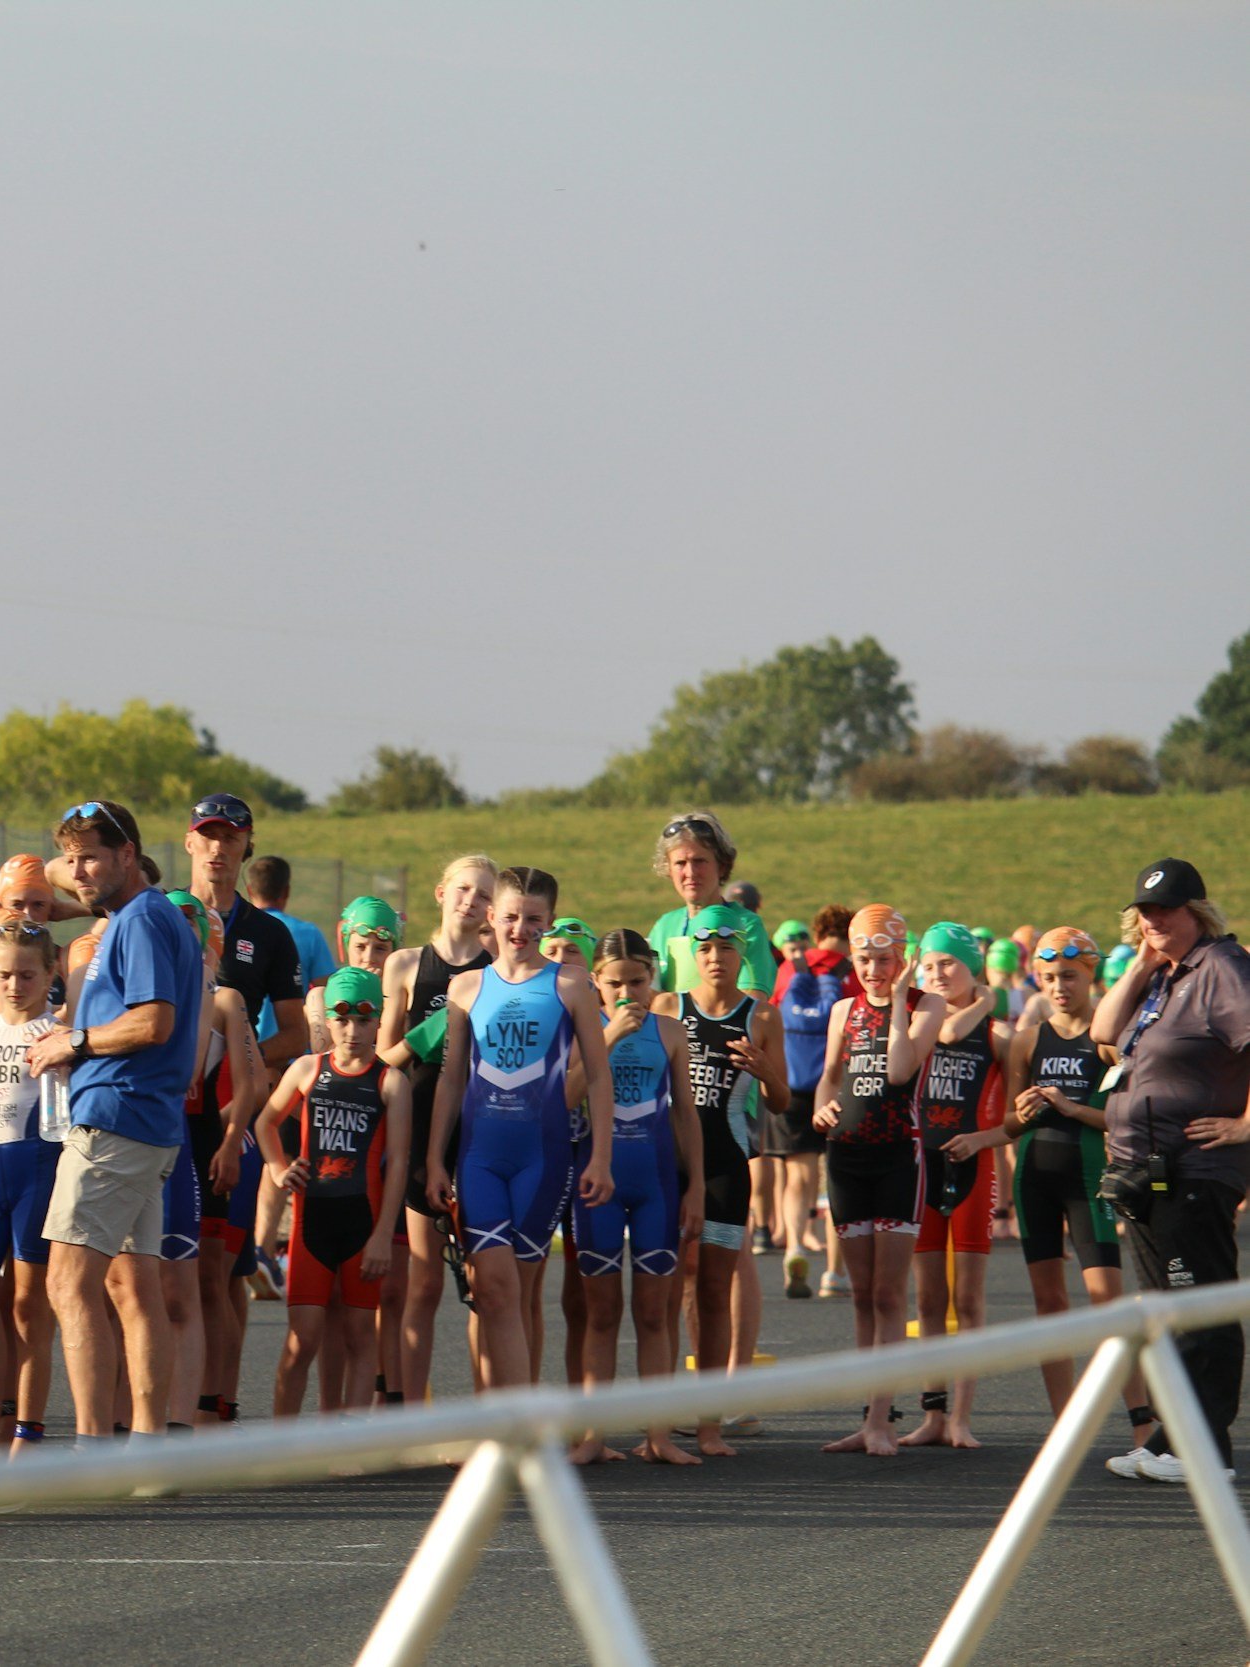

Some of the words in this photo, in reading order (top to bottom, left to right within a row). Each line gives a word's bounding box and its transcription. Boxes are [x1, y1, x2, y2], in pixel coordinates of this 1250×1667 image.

[485, 1021, 540, 1048] LYNE
[496, 1047, 525, 1068] SCO
[931, 1055, 977, 1080] UGHES
[1040, 1056, 1083, 1076] KIRK
[613, 1066, 654, 1087] RRETT
[852, 1076, 884, 1096] GBR
[1064, 1080, 1089, 1088] WEST
[614, 1086, 641, 1103] SCO
[929, 1076, 965, 1101] WAL
[311, 1097, 334, 1105] WELSH
[335, 1100, 377, 1112] TRIATHLON
[313, 1105, 368, 1132] EVANS
[319, 1128, 357, 1152] WAL
[190, 1158, 201, 1222] SCOTLAND
[547, 1166, 574, 1231] SCOTLAND
[1167, 1272, 1194, 1281] BRITISH
